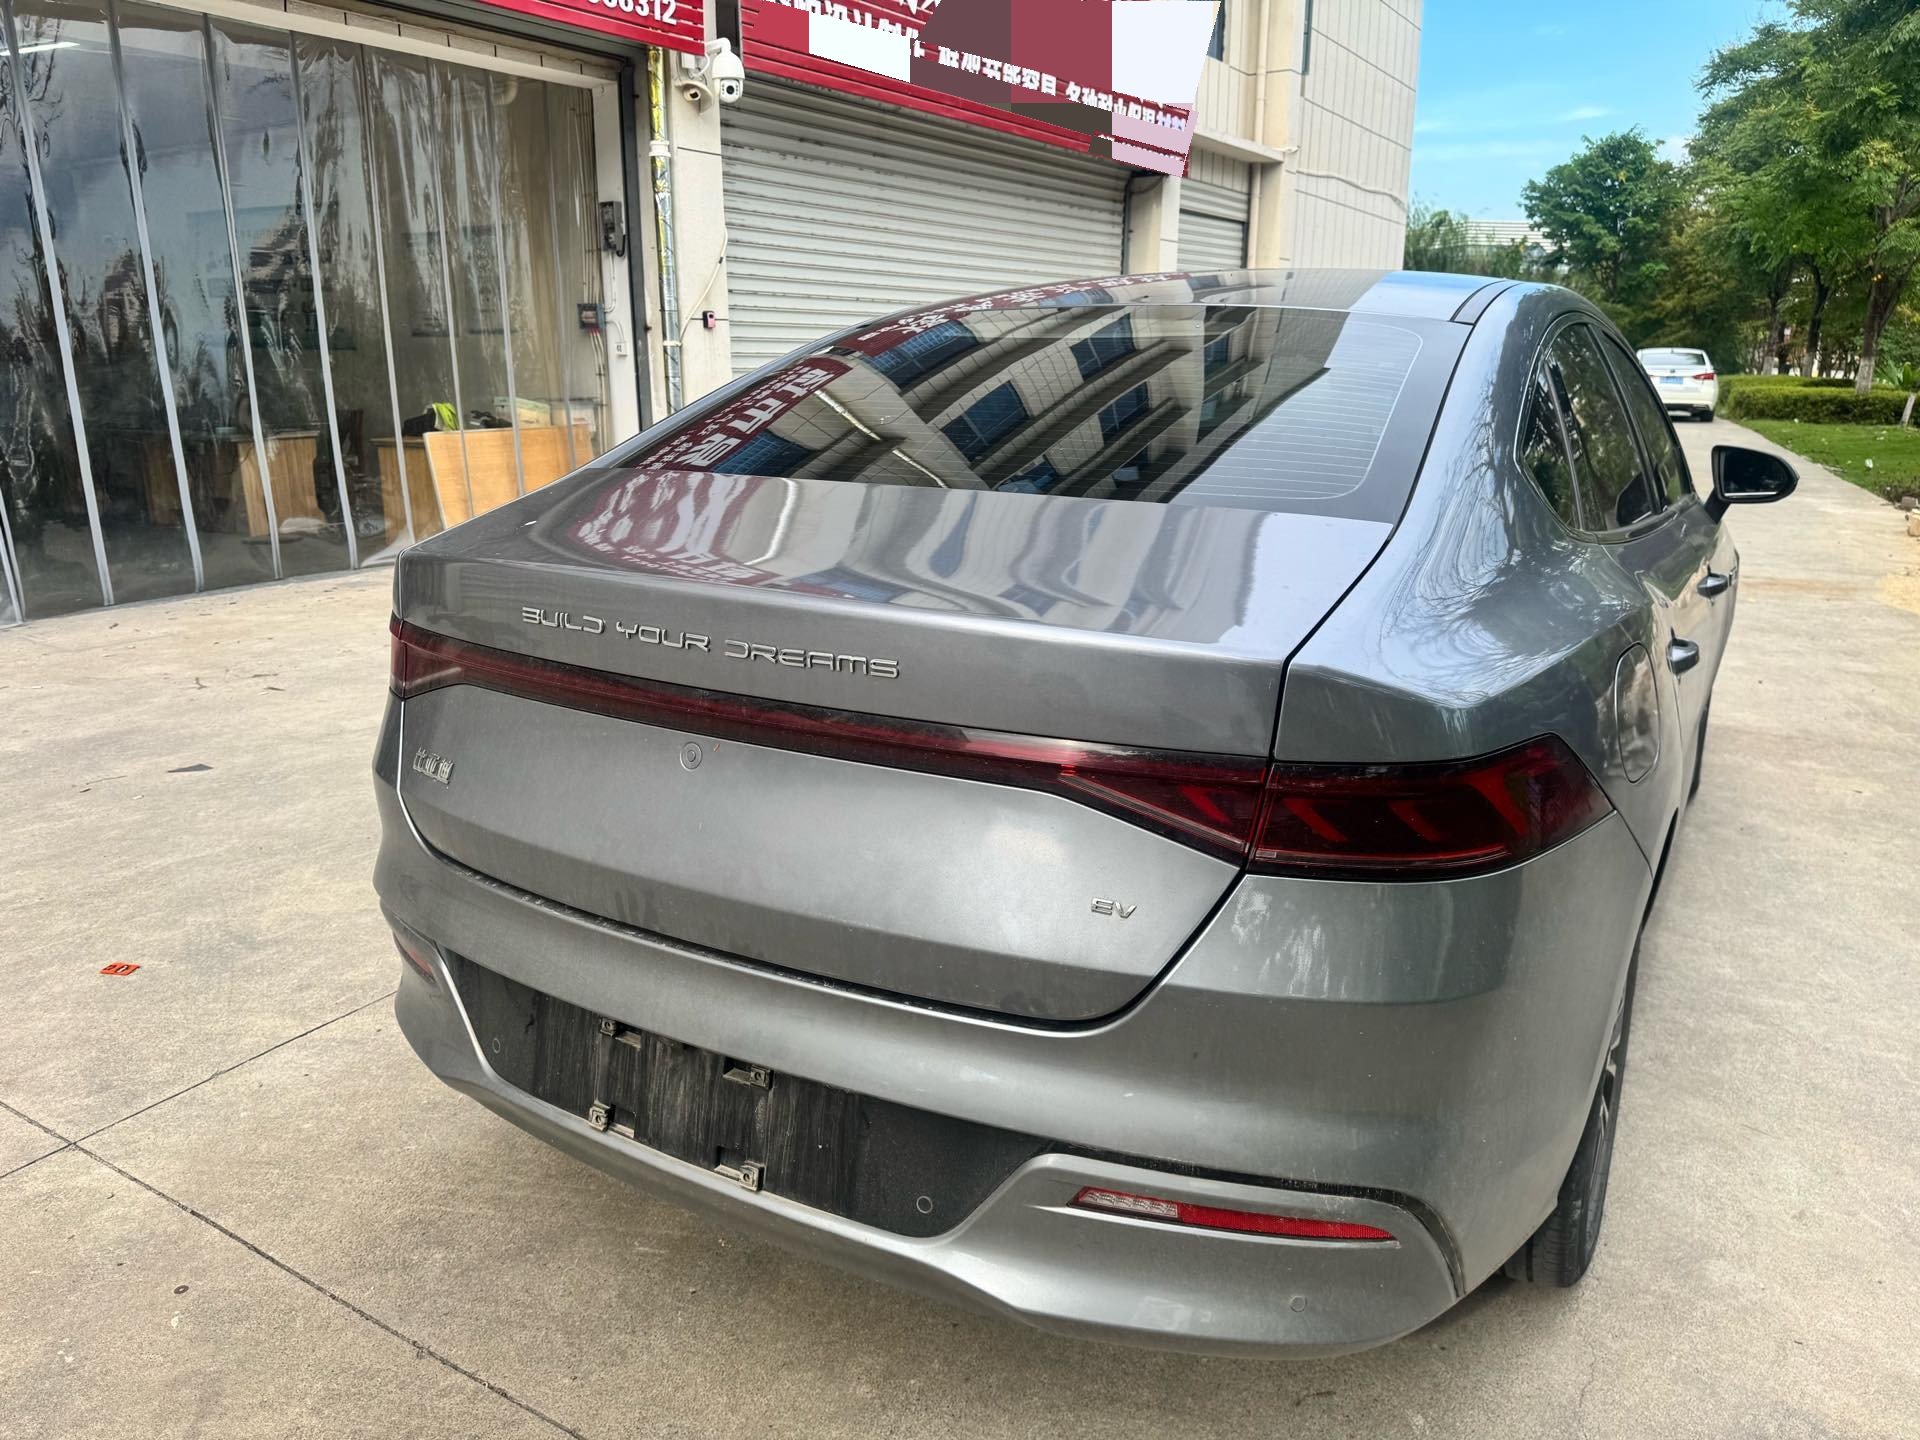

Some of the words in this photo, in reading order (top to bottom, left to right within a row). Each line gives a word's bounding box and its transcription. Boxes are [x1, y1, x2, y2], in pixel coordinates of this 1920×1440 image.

[522, 606, 605, 635] BUILD
[616, 621, 711, 653] YOUR
[724, 639, 900, 679] DREAMS
[1091, 898, 1137, 919] EV
